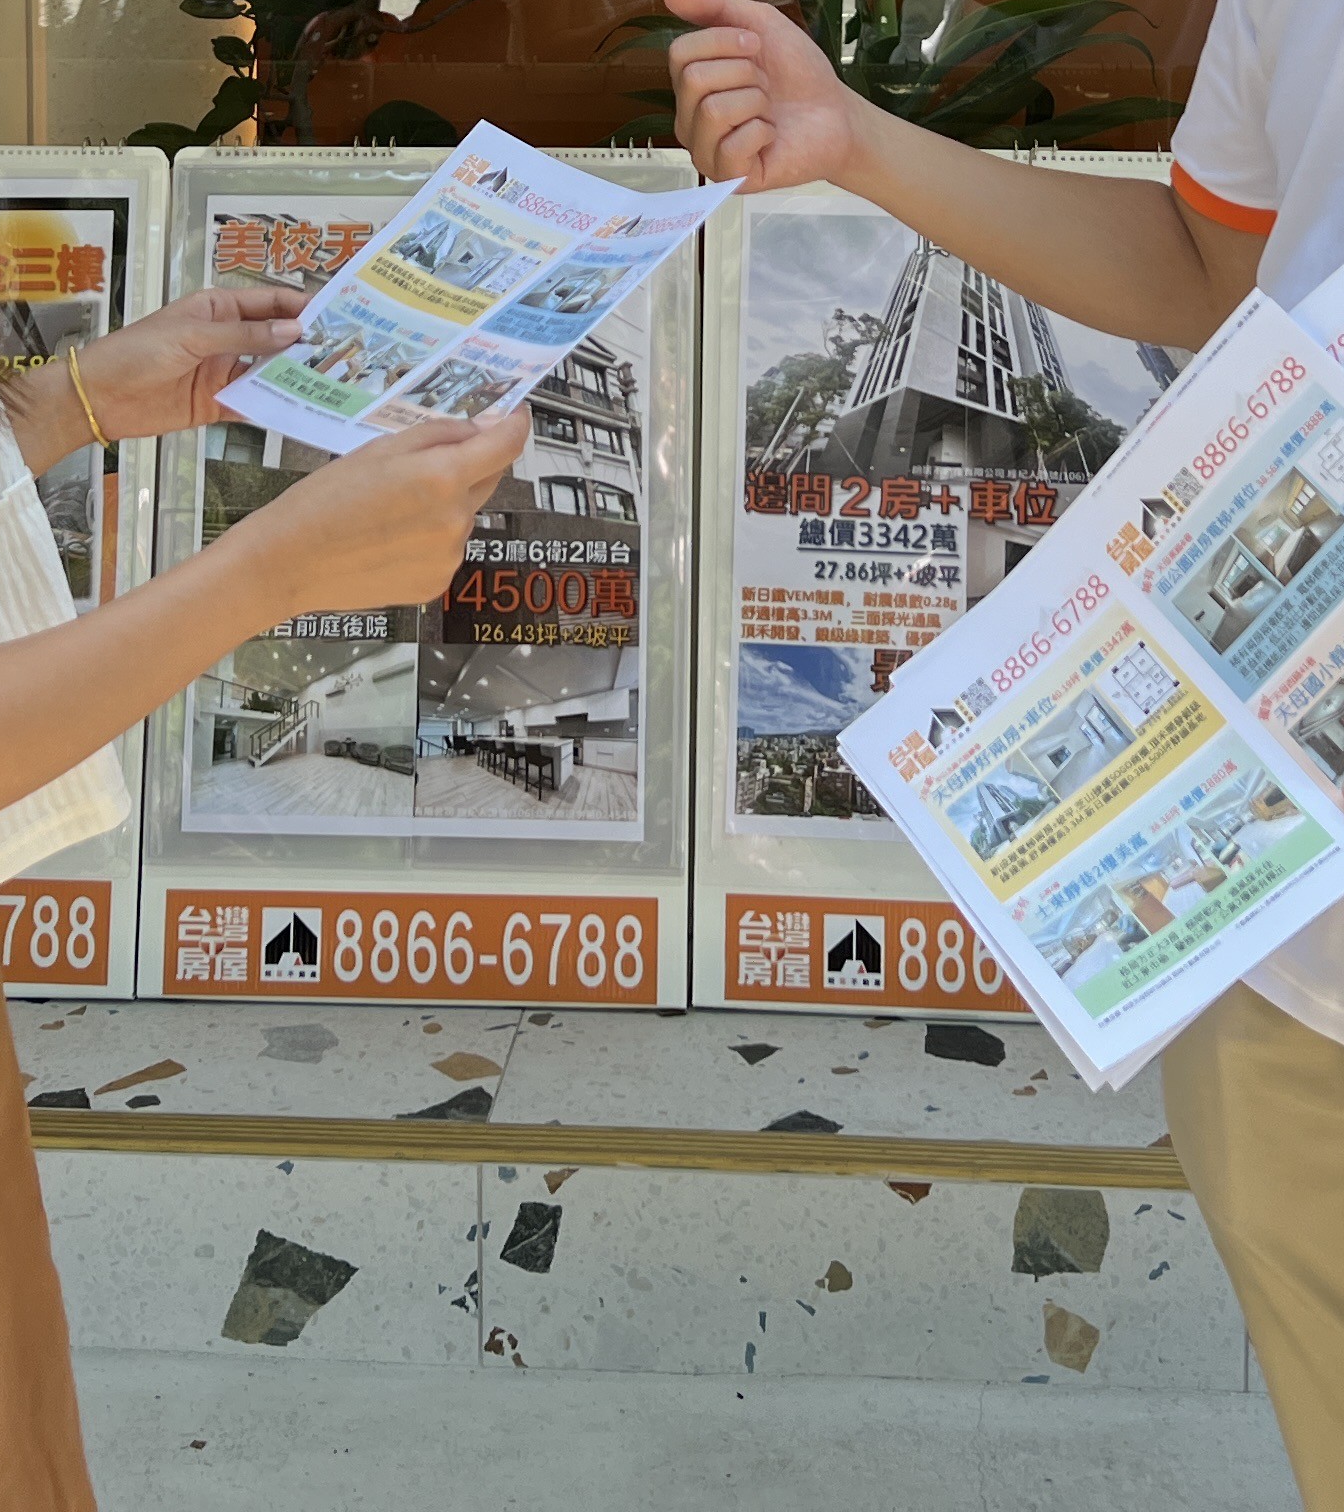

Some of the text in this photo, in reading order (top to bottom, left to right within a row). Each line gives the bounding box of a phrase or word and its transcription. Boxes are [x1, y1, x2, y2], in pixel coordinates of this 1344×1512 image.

[517, 191, 599, 232] 8866-6788
[1188, 352, 1309, 482] 8866-6788
[798, 518, 960, 553] 總價3342萬
[259, 614, 389, 638] 台前庭後院
[988, 571, 1112, 694] 8866-6788
[177, 904, 250, 942] 台灣
[738, 909, 811, 948] 台灣
[175, 946, 249, 982] 房屋
[333, 908, 646, 987] 8866-6788
[897, 917, 1006, 996] 886
[737, 951, 811, 989] 房屋
